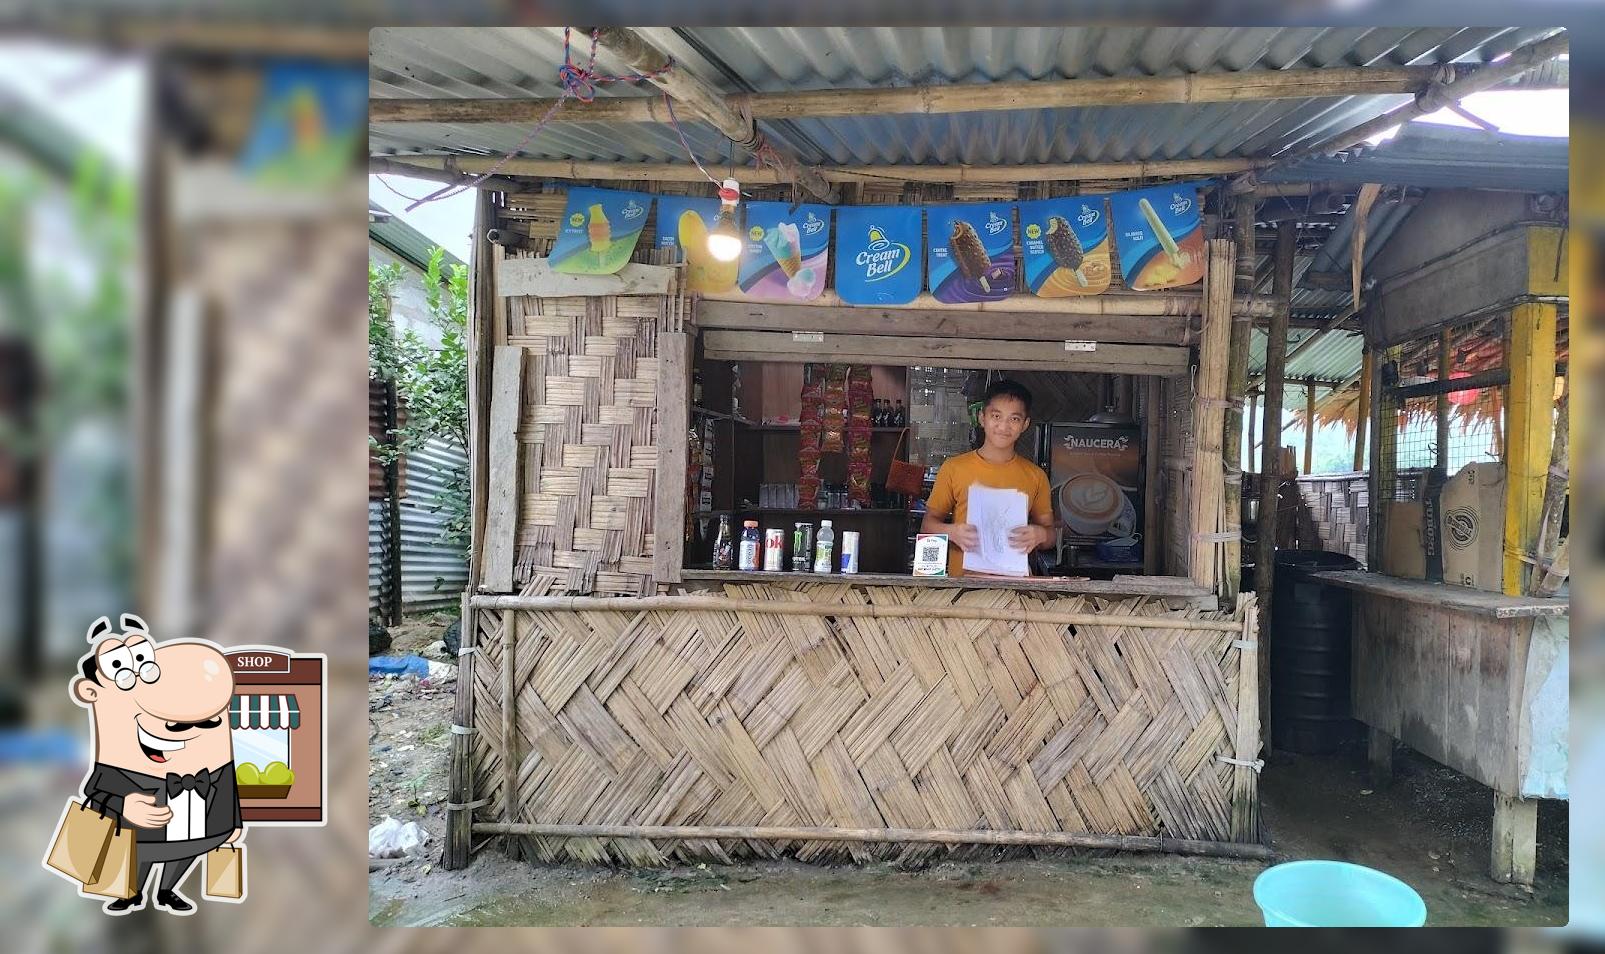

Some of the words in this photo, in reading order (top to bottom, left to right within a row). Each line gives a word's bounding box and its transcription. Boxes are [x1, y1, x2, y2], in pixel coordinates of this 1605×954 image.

[1077, 212, 1096, 221] Cream
[803, 221, 821, 229] Cream
[985, 221, 1003, 229] Cream
[856, 249, 900, 265] Cream
[867, 260, 893, 277] Bell
[1071, 438, 1121, 449] NAUCERA
